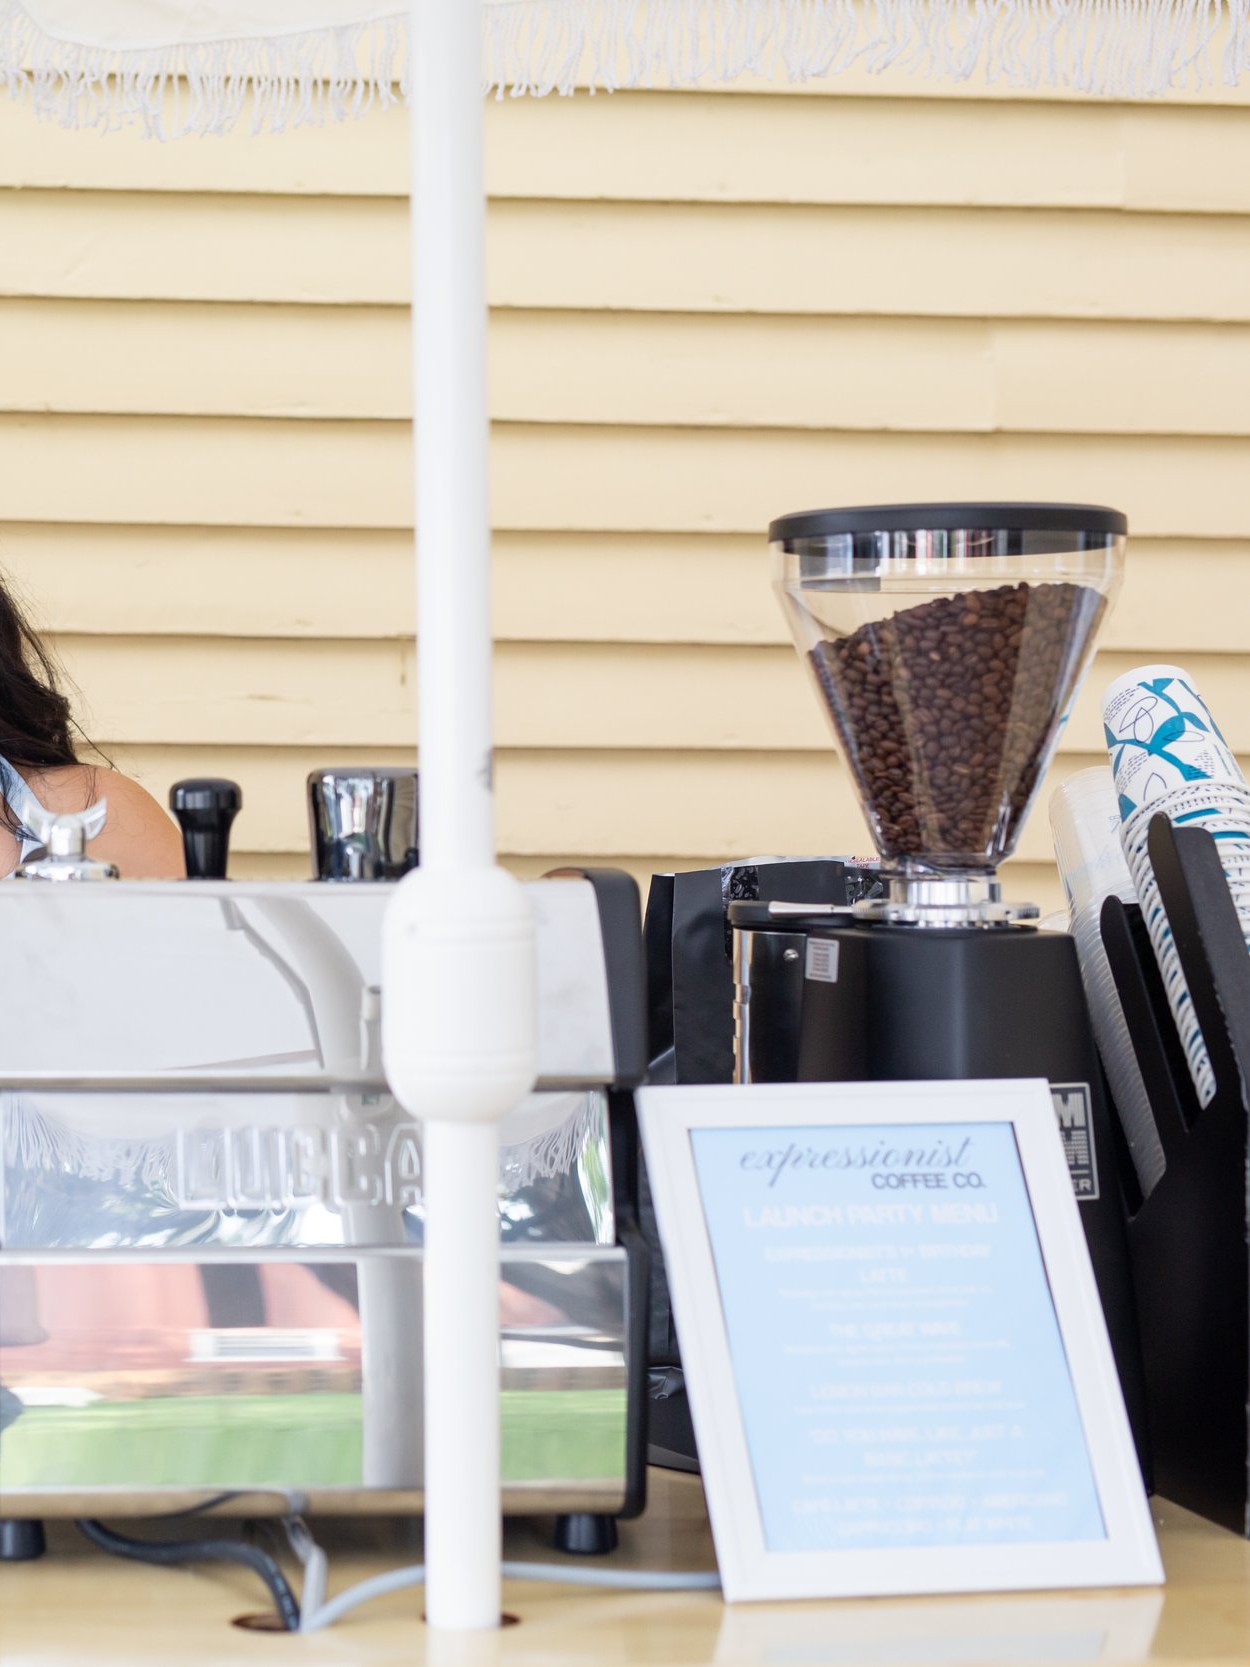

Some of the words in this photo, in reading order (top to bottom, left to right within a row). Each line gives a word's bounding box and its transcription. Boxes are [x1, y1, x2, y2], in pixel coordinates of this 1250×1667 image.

[739, 1136, 973, 1188] expressionist
[871, 1172, 949, 1190] COFFEE
[952, 1171, 986, 1189] CO.
[742, 1205, 842, 1228] LAUNCH
[846, 1203, 924, 1225] PARTY
[929, 1202, 999, 1224] MENU
